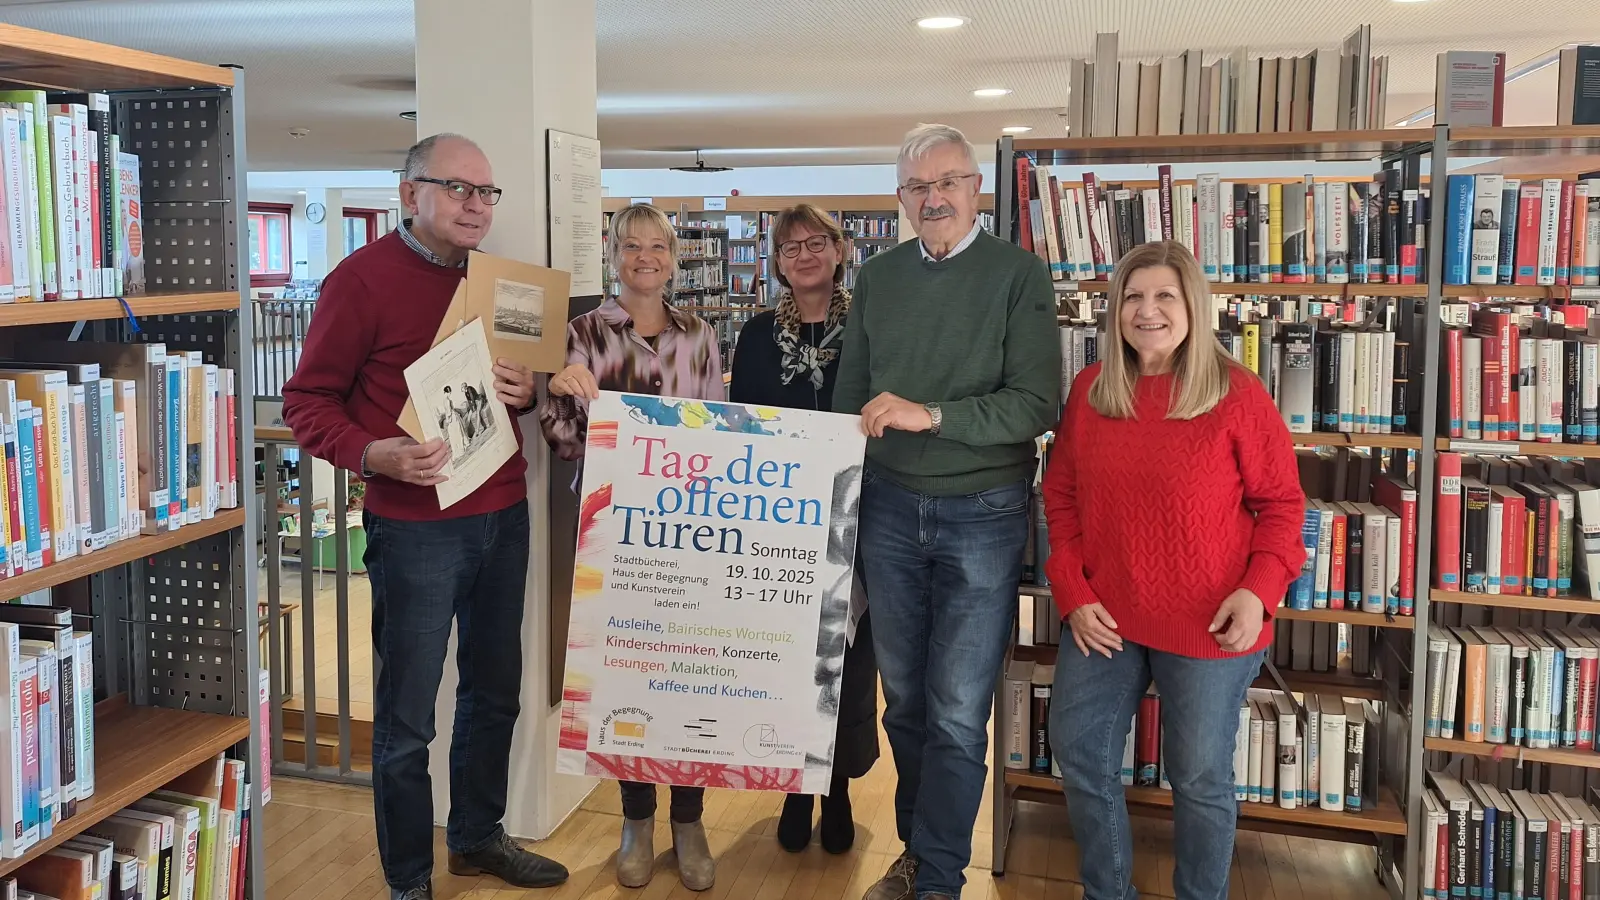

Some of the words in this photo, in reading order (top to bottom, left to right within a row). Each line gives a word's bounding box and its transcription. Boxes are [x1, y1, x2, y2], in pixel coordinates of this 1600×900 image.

[102, 111, 110, 146] ENTSTEH
[80, 121, 89, 171] schwange
[61, 136, 72, 202] Geburtsbuch
[81, 173, 89, 192] sind
[81, 194, 90, 213] Wir
[1087, 182, 1096, 216] MAHLZEIT!
[1162, 174, 1171, 213] Vertreibung
[64, 205, 73, 223] Das
[60, 405, 68, 443] Massage
[91, 383, 99, 437] artgerecht
[23, 445, 34, 477] PEKIP
[62, 449, 70, 475] Baby
[632, 435, 713, 494] Tag
[727, 444, 800, 489] der
[1443, 478, 1460, 486] DDR
[657, 475, 823, 526] offenen
[613, 504, 744, 555] Türen
[751, 542, 818, 564] Sonntag
[613, 554, 680, 570] Stadtbücherei,
[726, 565, 748, 580] 19.
[752, 567, 773, 582] 10.
[777, 569, 815, 584] 2025
[611, 581, 629, 592] und
[632, 582, 686, 596] Kunstverein
[613, 568, 635, 579] Haus
[638, 570, 653, 580] der
[656, 571, 709, 586] Begegnung
[1371, 568, 1379, 590] Helmut
[654, 599, 680, 609] laden
[683, 600, 700, 611] ein!
[724, 586, 743, 600] 13
[759, 588, 777, 602] 17
[783, 590, 813, 606] Uhr
[608, 616, 665, 635] Ausleihe,
[668, 622, 732, 638] Bairisches
[736, 627, 795, 644] Wortquiz,
[606, 635, 719, 658] Kinderschminken,
[722, 646, 781, 663] Konzerte,
[604, 655, 668, 673] Lesungen,
[671, 662, 738, 680] Malaktion,
[22, 678, 34, 707] colo
[649, 679, 689, 694] Kaffee
[693, 683, 717, 696] und
[83, 693, 92, 752] Naturkosmetik
[598, 726, 606, 746] Haus
[602, 714, 613, 726] der
[612, 707, 654, 723] Begegnung
[23, 708, 36, 767] personal
[627, 741, 645, 749] Erding
[664, 746, 711, 755] STADTBÜCHEREI
[1354, 726, 1363, 755] Strauß
[1456, 810, 1466, 843] Schröde
[1505, 820, 1513, 841] SÖDER
[185, 829, 197, 876] YOGA
[1550, 831, 1559, 873] STEINMEIER
[1574, 829, 1582, 866] WAGENKNECH
[1586, 848, 1597, 863] Klaus
[162, 857, 171, 895] dummies
[1457, 848, 1466, 885] Gerhard
